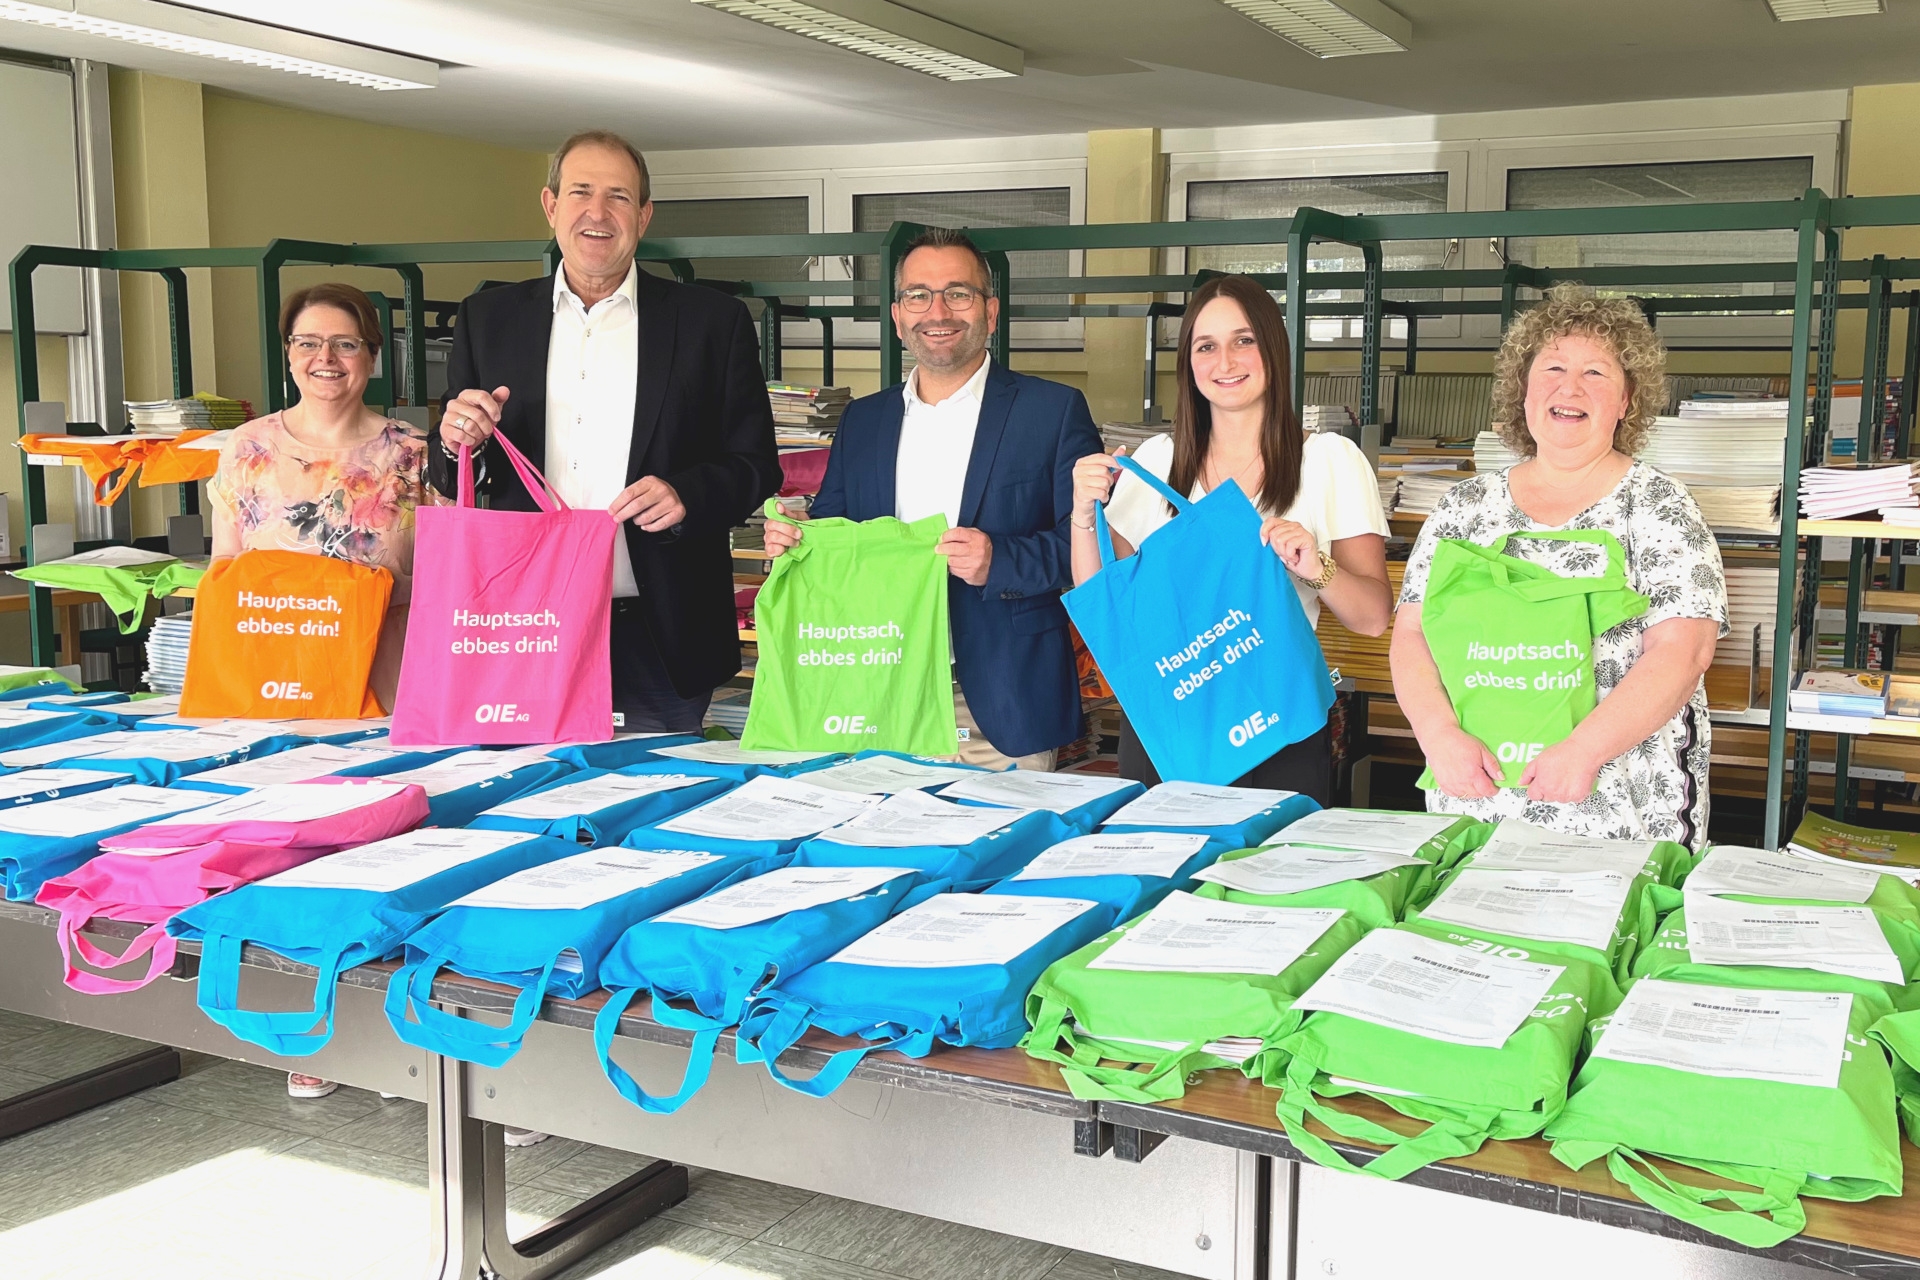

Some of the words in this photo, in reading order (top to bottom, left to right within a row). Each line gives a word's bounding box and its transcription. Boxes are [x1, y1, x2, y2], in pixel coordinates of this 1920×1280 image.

[238, 591, 342, 614] Hauptsach,
[237, 617, 295, 635] ebbes
[299, 619, 339, 637] drin!
[452, 608, 561, 631] Hauptsach,
[798, 619, 905, 644] Hauptsach,
[450, 636, 511, 655] ebbes
[514, 634, 559, 654] drin!
[1155, 609, 1251, 678] Hauptsach,
[1466, 639, 1585, 665] Hauptsach,
[797, 648, 857, 667] ebbes
[860, 647, 903, 666] drin!
[1173, 659, 1223, 701] ebbes
[1223, 627, 1264, 665] drin!
[260, 681, 301, 700] OIE
[300, 691, 313, 701] AG
[1464, 670, 1528, 691] ebbes
[1533, 667, 1583, 692] drin!
[475, 703, 517, 724] OIE
[514, 713, 530, 723] AG
[823, 714, 866, 735] OIE
[864, 724, 878, 735] AG
[1228, 710, 1267, 748] OIE
[1266, 713, 1280, 727] AG
